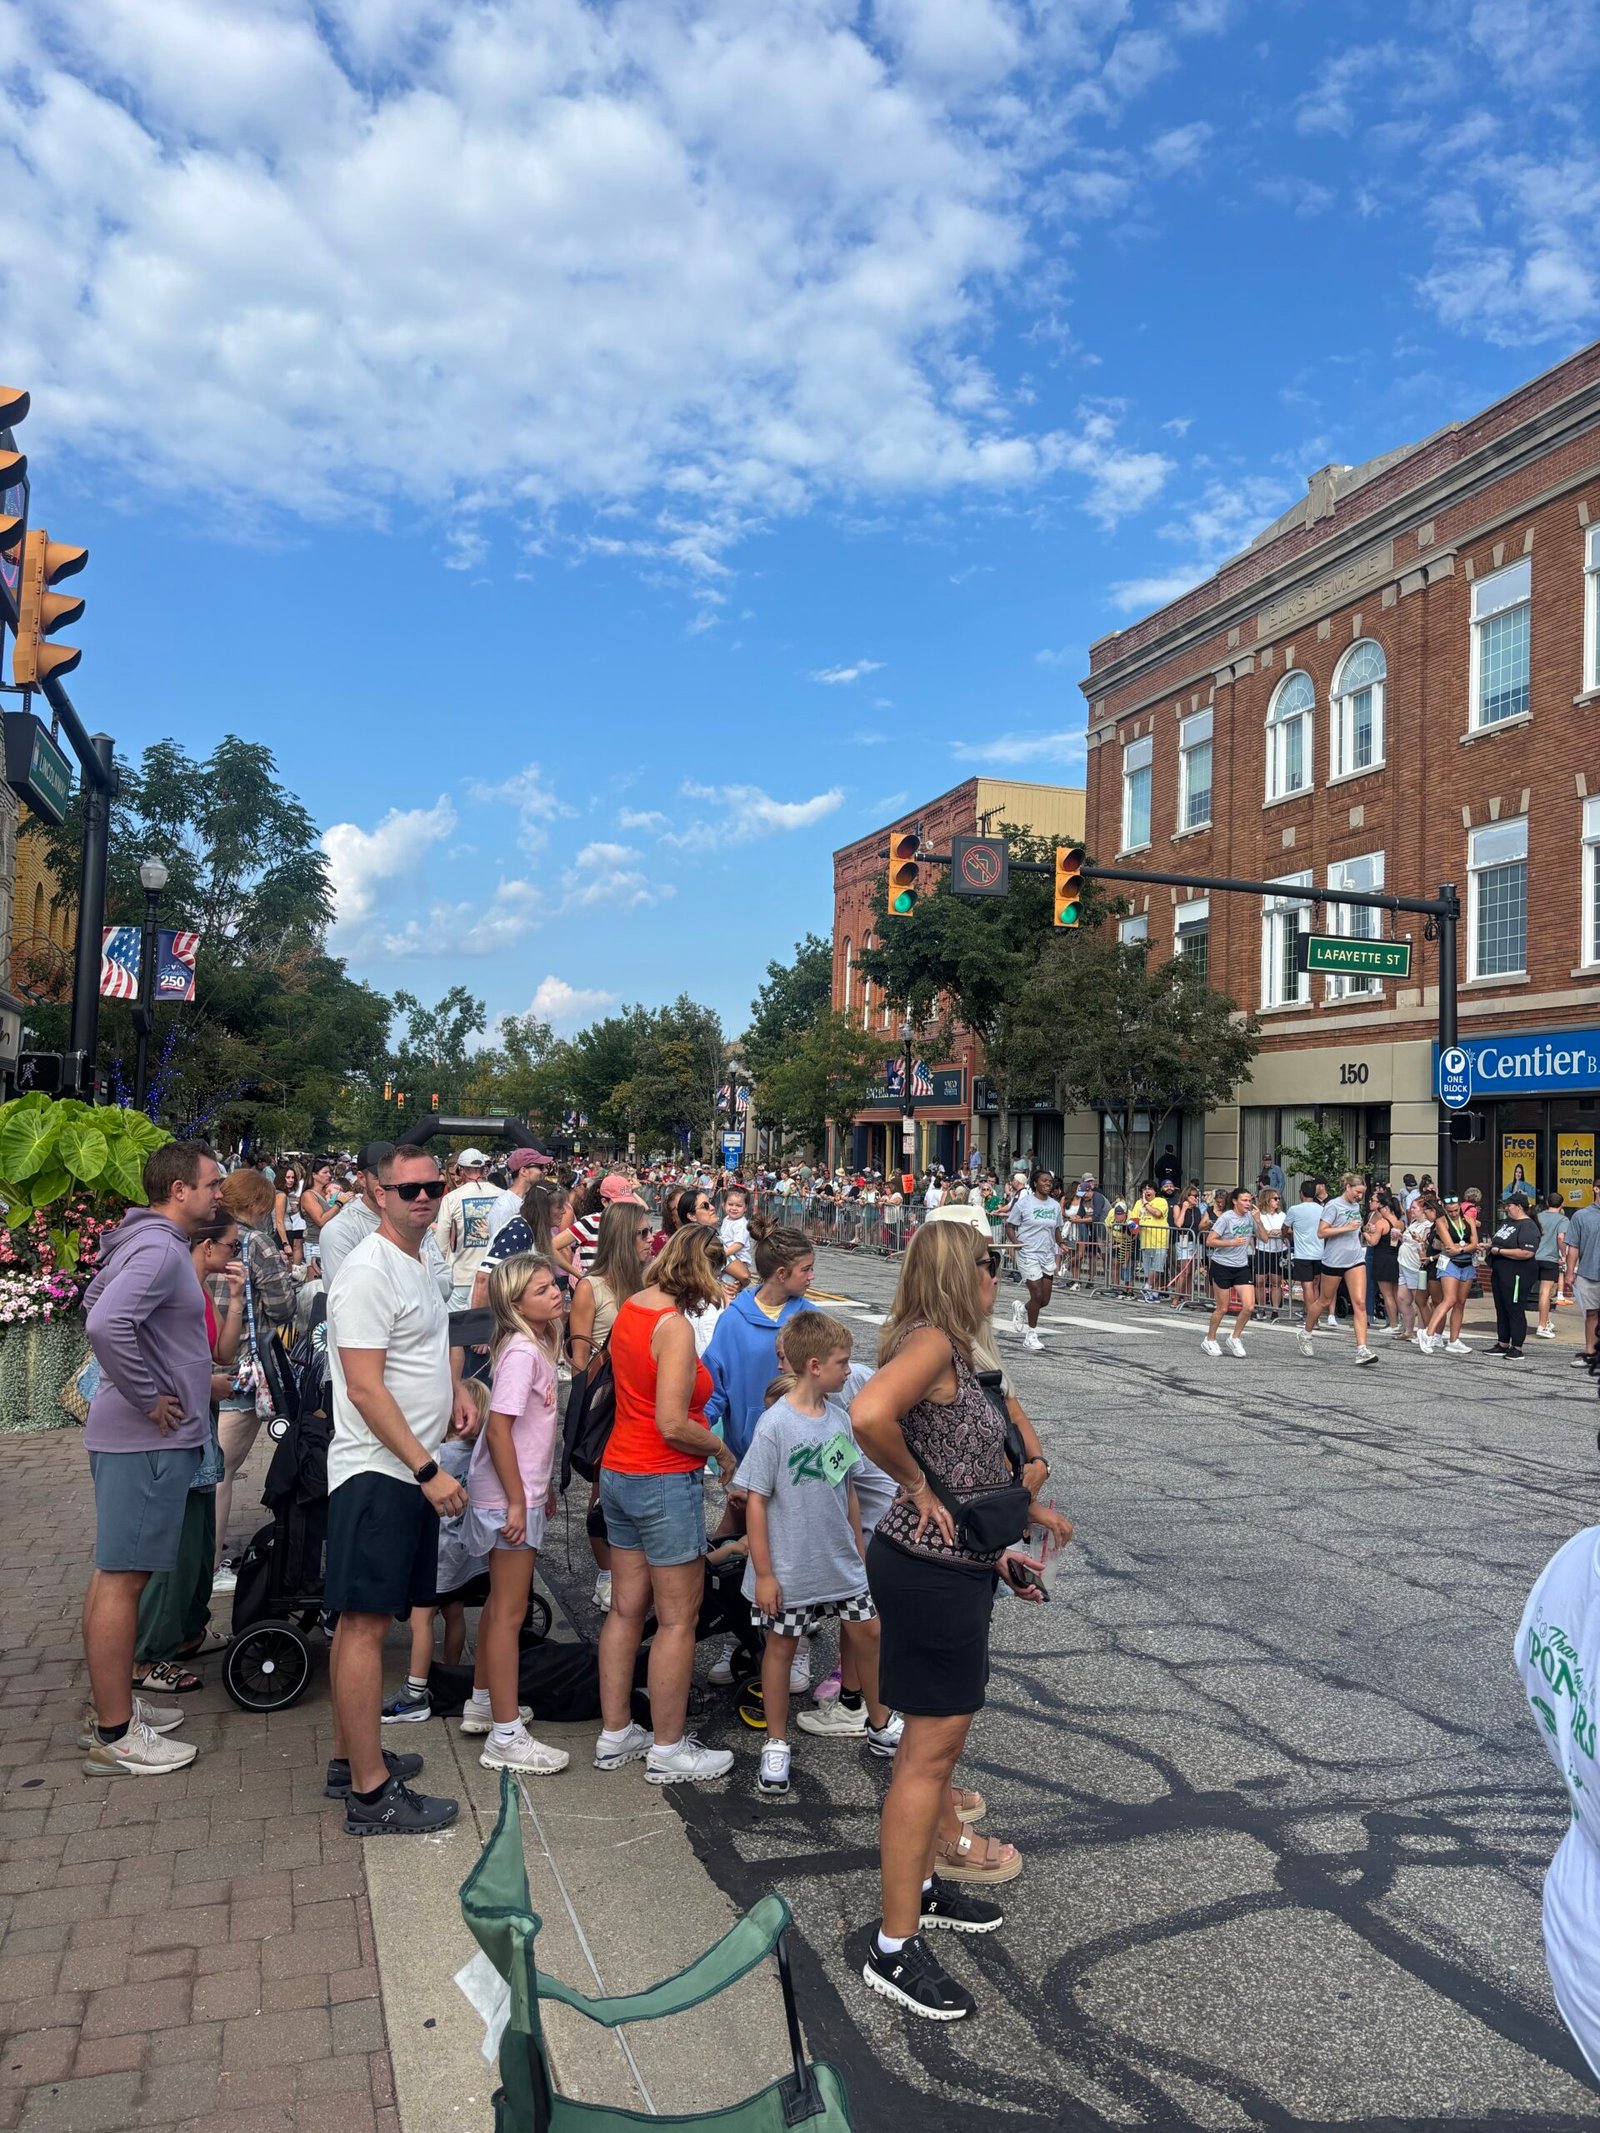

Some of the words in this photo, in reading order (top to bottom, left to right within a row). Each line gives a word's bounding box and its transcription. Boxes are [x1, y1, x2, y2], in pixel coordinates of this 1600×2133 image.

[1269, 596, 1307, 628] ELKS
[1312, 556, 1378, 605] TEMPLE
[1317, 948, 1381, 964] LAFAYETTE
[1386, 954, 1400, 965] ST
[160, 975, 186, 987] 250
[1477, 1043, 1586, 1079] Centier
[1340, 1063, 1369, 1084] 150
[1447, 1075, 1464, 1083] ONE
[1443, 1084, 1468, 1093] BLOCK
[1504, 1136, 1535, 1149] Free
[1504, 1150, 1535, 1159] Checking
[1560, 1147, 1593, 1158] perfect
[829, 1449, 844, 1470] 34
